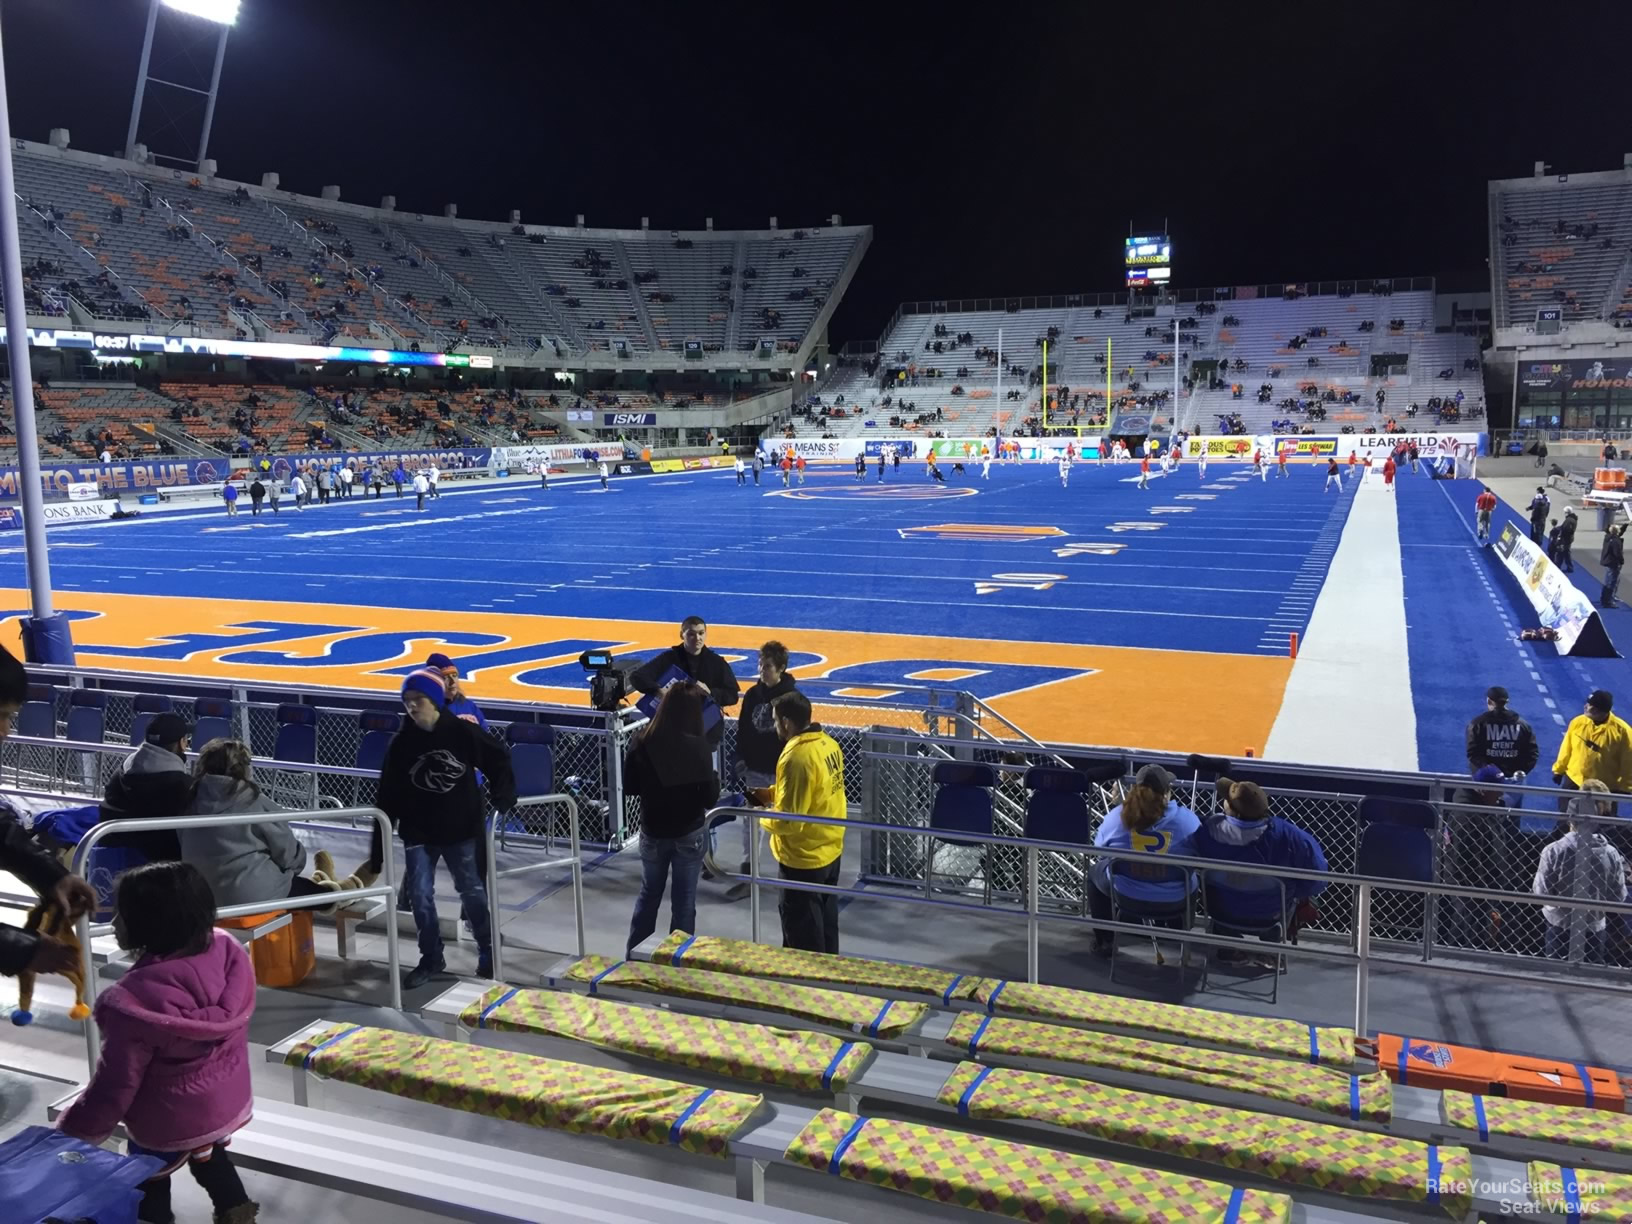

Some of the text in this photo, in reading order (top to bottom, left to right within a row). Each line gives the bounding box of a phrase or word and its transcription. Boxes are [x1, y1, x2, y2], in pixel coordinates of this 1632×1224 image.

[1544, 312, 1556, 320] 101
[613, 414, 647, 425] ISMI
[551, 446, 624, 460] LITHIAFOISE.COM
[795, 442, 826, 452] MEANS
[346, 456, 368, 473] OF
[41, 470, 75, 490] TO
[79, 466, 129, 489] THE
[132, 464, 190, 487] BLUE
[44, 504, 107, 518] ONS BANK
[1486, 723, 1521, 741] MAV
[1492, 741, 1515, 749] EVENT
[1485, 749, 1518, 758] SERVICES
[824, 750, 841, 777] MAV
